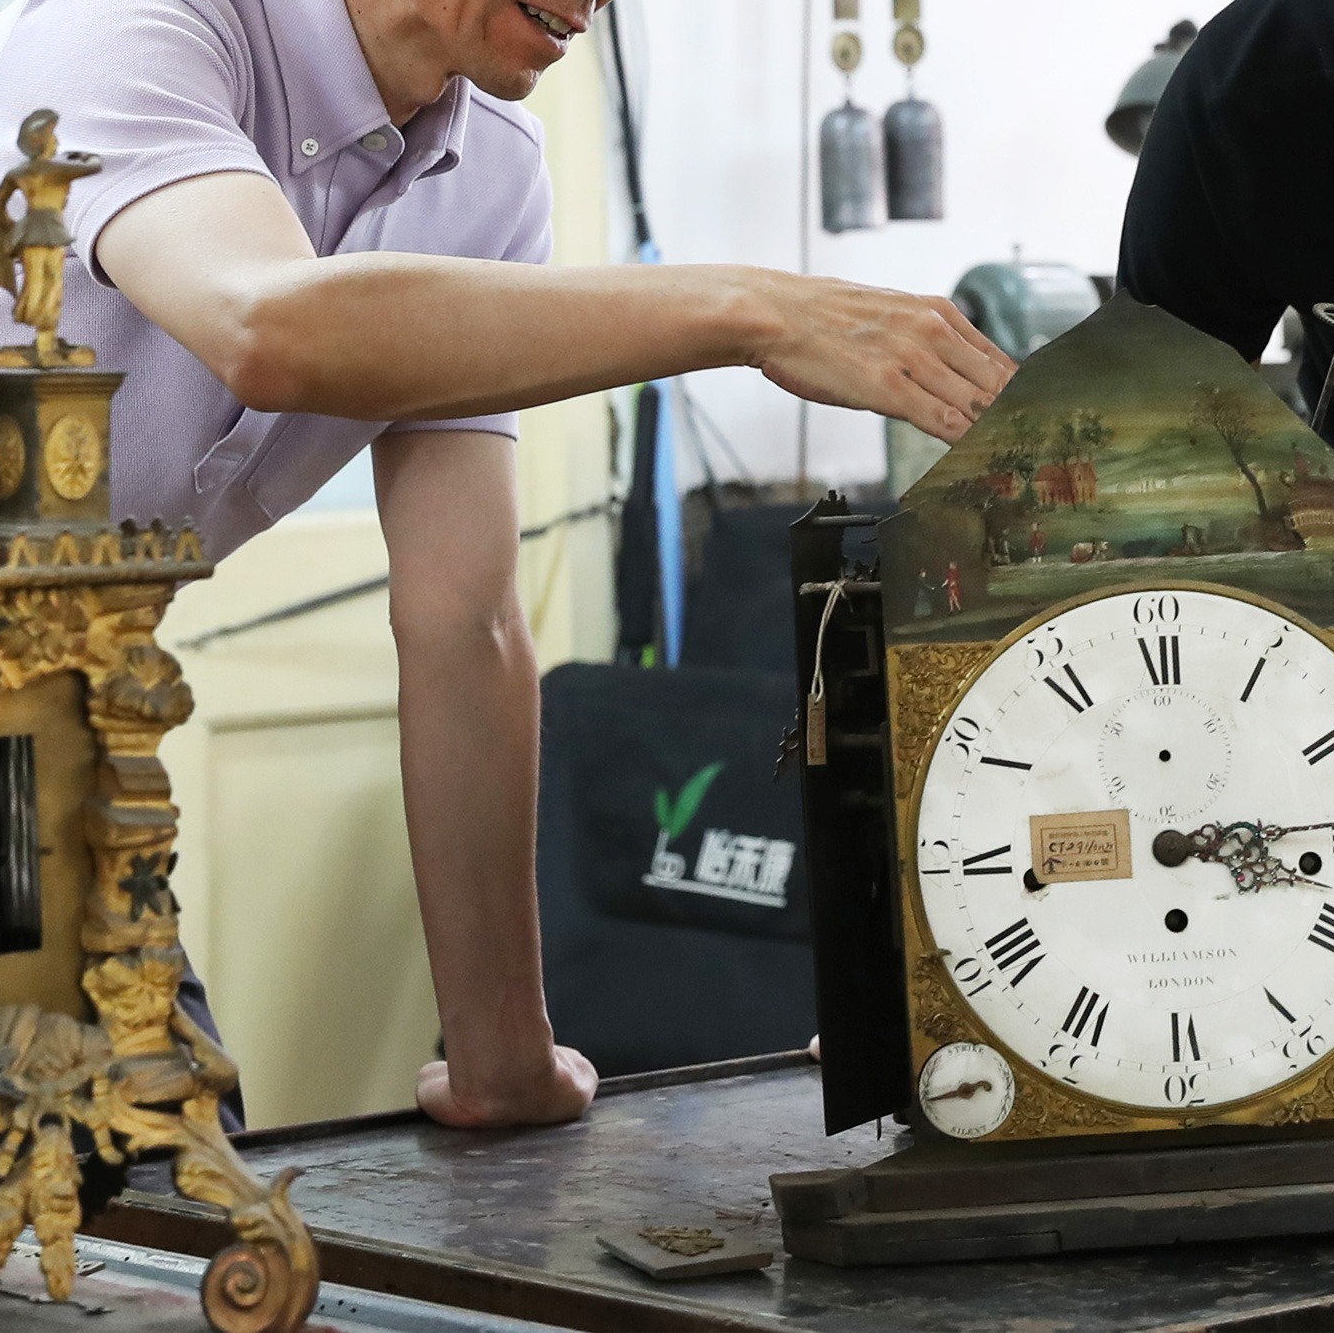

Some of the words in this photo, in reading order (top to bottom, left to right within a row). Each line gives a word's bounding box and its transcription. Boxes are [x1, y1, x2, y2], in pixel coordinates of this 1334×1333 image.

[1133, 595, 1180, 624] 60
[1025, 624, 1064, 668] 55
[1137, 635, 1182, 686] XII
[1153, 695, 1171, 708] 60
[944, 716, 981, 764] 50
[1127, 947, 1238, 964] WILLIAMSON
[1148, 975, 1215, 989] LONDON
[950, 1124, 988, 1135] SILENT
